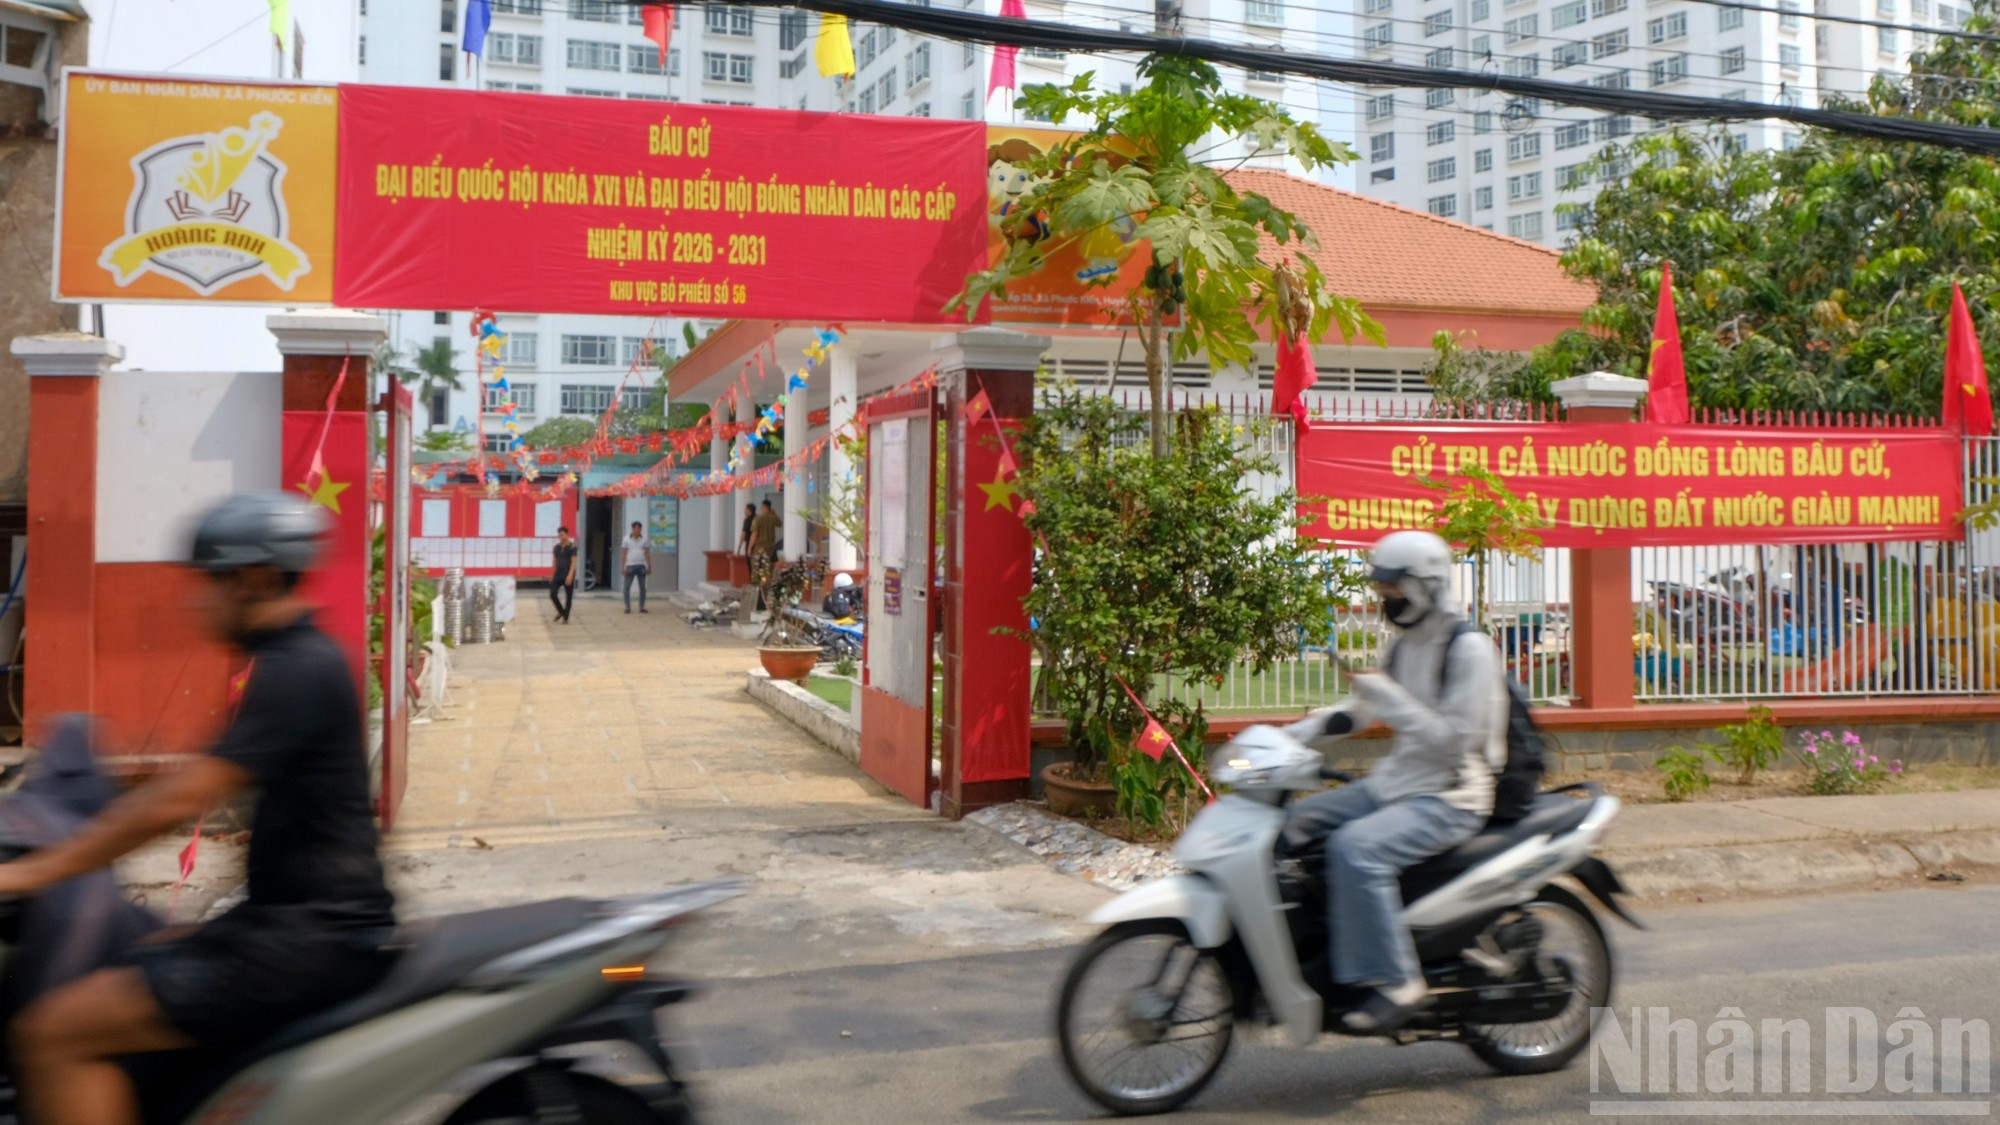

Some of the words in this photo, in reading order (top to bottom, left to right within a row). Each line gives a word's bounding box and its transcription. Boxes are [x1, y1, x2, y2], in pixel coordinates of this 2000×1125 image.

[110, 81, 141, 95] BAN
[145, 79, 186, 97] NHÂN
[190, 82, 220, 99] DÂN
[649, 115, 683, 156] BẦU
[687, 117, 711, 158] CỬ
[376, 163, 407, 204] ĐẠI
[411, 153, 453, 199] BIỂU
[457, 157, 504, 203] QUỐC
[508, 164, 538, 209] HỘI
[542, 166, 589, 205] KHÓA
[593, 174, 620, 207] XVI
[625, 170, 647, 208] VÀ
[650, 176, 679, 216] ĐẠI
[683, 167, 721, 211] BIỂU
[725, 175, 752, 219] HỘI
[756, 173, 801, 215] ĐỒNG
[804, 179, 849, 217] NHÂN
[853, 181, 886, 218] DÂN
[889, 183, 921, 220] CÁC
[925, 181, 956, 221] CẤP
[145, 227, 216, 253] HOÀNG
[223, 229, 265, 255] ANH
[587, 222, 643, 267] NHIỆM
[647, 224, 669, 262] KỲ
[672, 231, 713, 264] 2026
[728, 234, 766, 266] 2031
[610, 280, 633, 301] KHU
[636, 279, 658, 306] VỰC
[660, 276, 676, 303] BỎ
[678, 277, 711, 304] PHIẾU
[714, 277, 729, 304] SỐ
[732, 284, 746, 304] 56
[1391, 435, 1436, 477] CỬ
[1441, 445, 1489, 475] TRI
[1498, 435, 1539, 477] CẢ
[1547, 440, 1627, 477] NƯỚC
[1634, 436, 1709, 477] ĐỒNG
[1717, 440, 1785, 477] LÒNG
[1792, 437, 1843, 477] BẦU
[1327, 498, 1435, 531] CHUNG
[1569, 495, 1648, 535] DỰNG
[1655, 487, 1705, 528] ĐẤT
[1713, 491, 1785, 528] NƯỚC
[1792, 490, 1850, 526] GIÀU
[1858, 495, 1940, 531] MẠNH!
